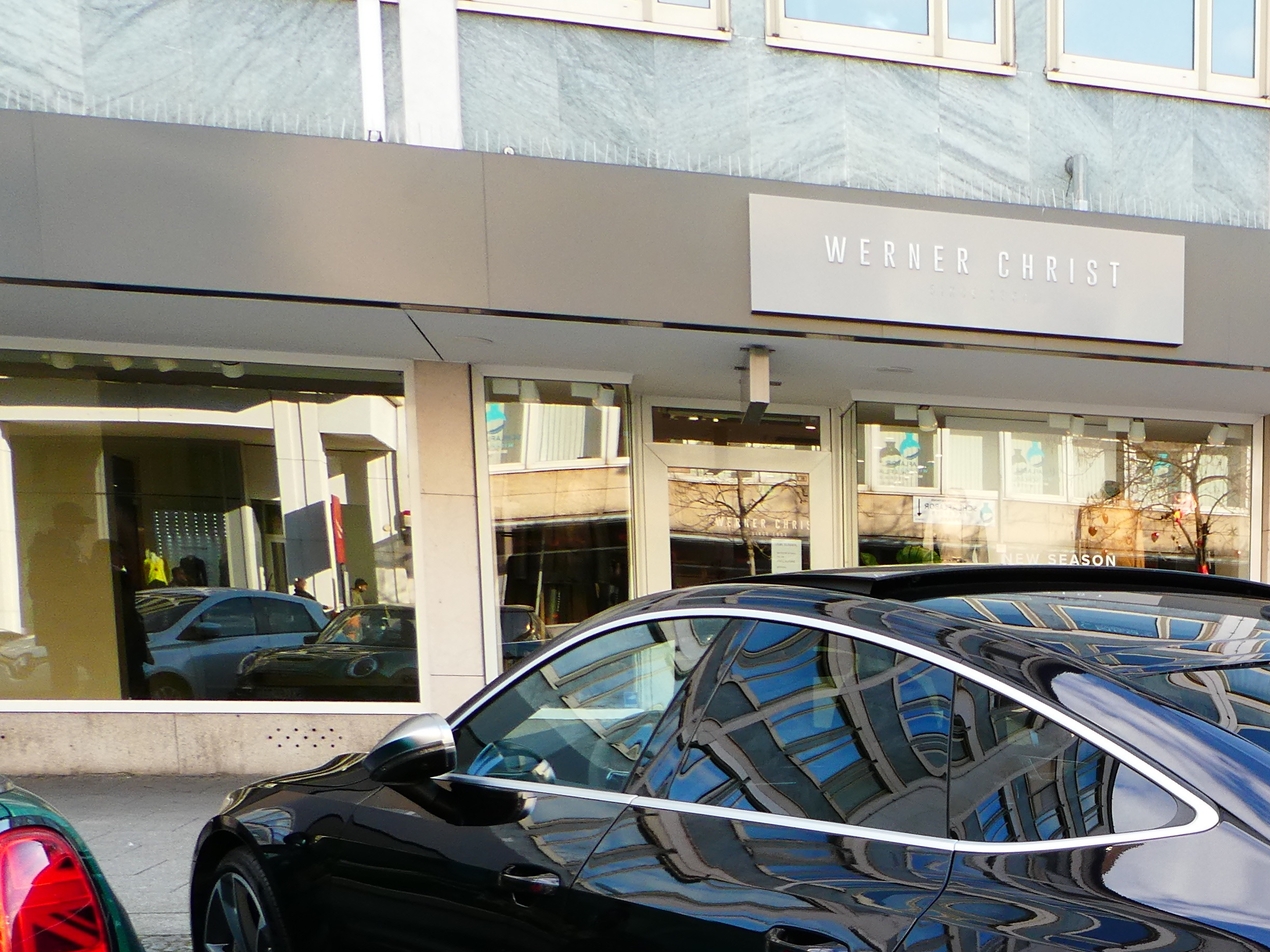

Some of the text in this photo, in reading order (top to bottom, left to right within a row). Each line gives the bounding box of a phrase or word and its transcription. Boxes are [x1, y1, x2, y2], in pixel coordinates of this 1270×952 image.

[824, 234, 1120, 288] WERNER CHRIST
[714, 517, 811, 530] WERNER CHRIS
[1003, 552, 1116, 567] NEW SEASON
